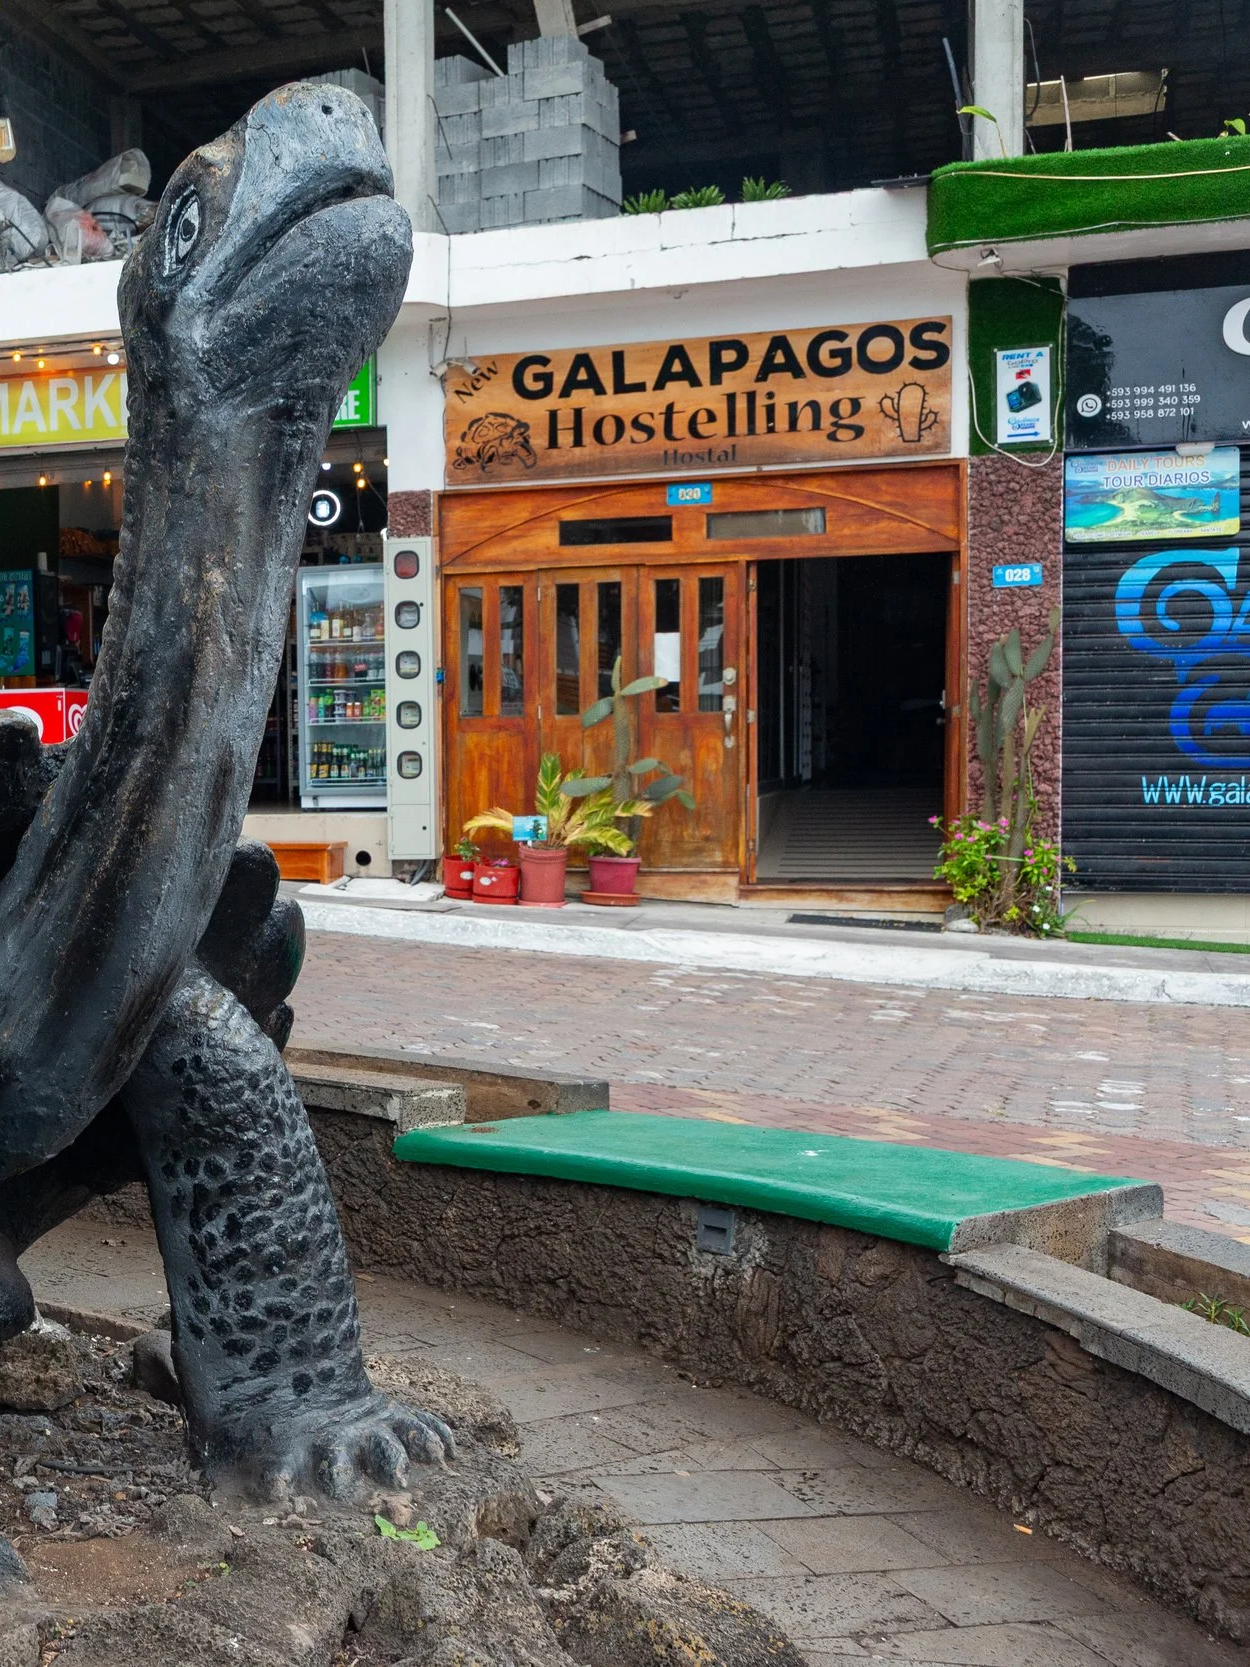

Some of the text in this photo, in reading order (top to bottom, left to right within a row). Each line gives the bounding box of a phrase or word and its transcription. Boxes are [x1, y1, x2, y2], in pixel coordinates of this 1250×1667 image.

[512, 321, 950, 400] GALAPAGOS
[1002, 352, 1031, 360] RENT
[453, 361, 499, 404] New
[1106, 383, 1196, 396] +593 994 491 136
[1106, 394, 1201, 408] +593 999 340 359
[545, 390, 866, 450] Hostelling
[1106, 407, 1194, 420] +593 958 872 101
[663, 444, 737, 466] Hostal
[1107, 456, 1149, 472] DAILY
[1154, 454, 1205, 469] TOURS
[1103, 471, 1210, 489] TOUR DIARIOS
[1005, 568, 1031, 582] 028
